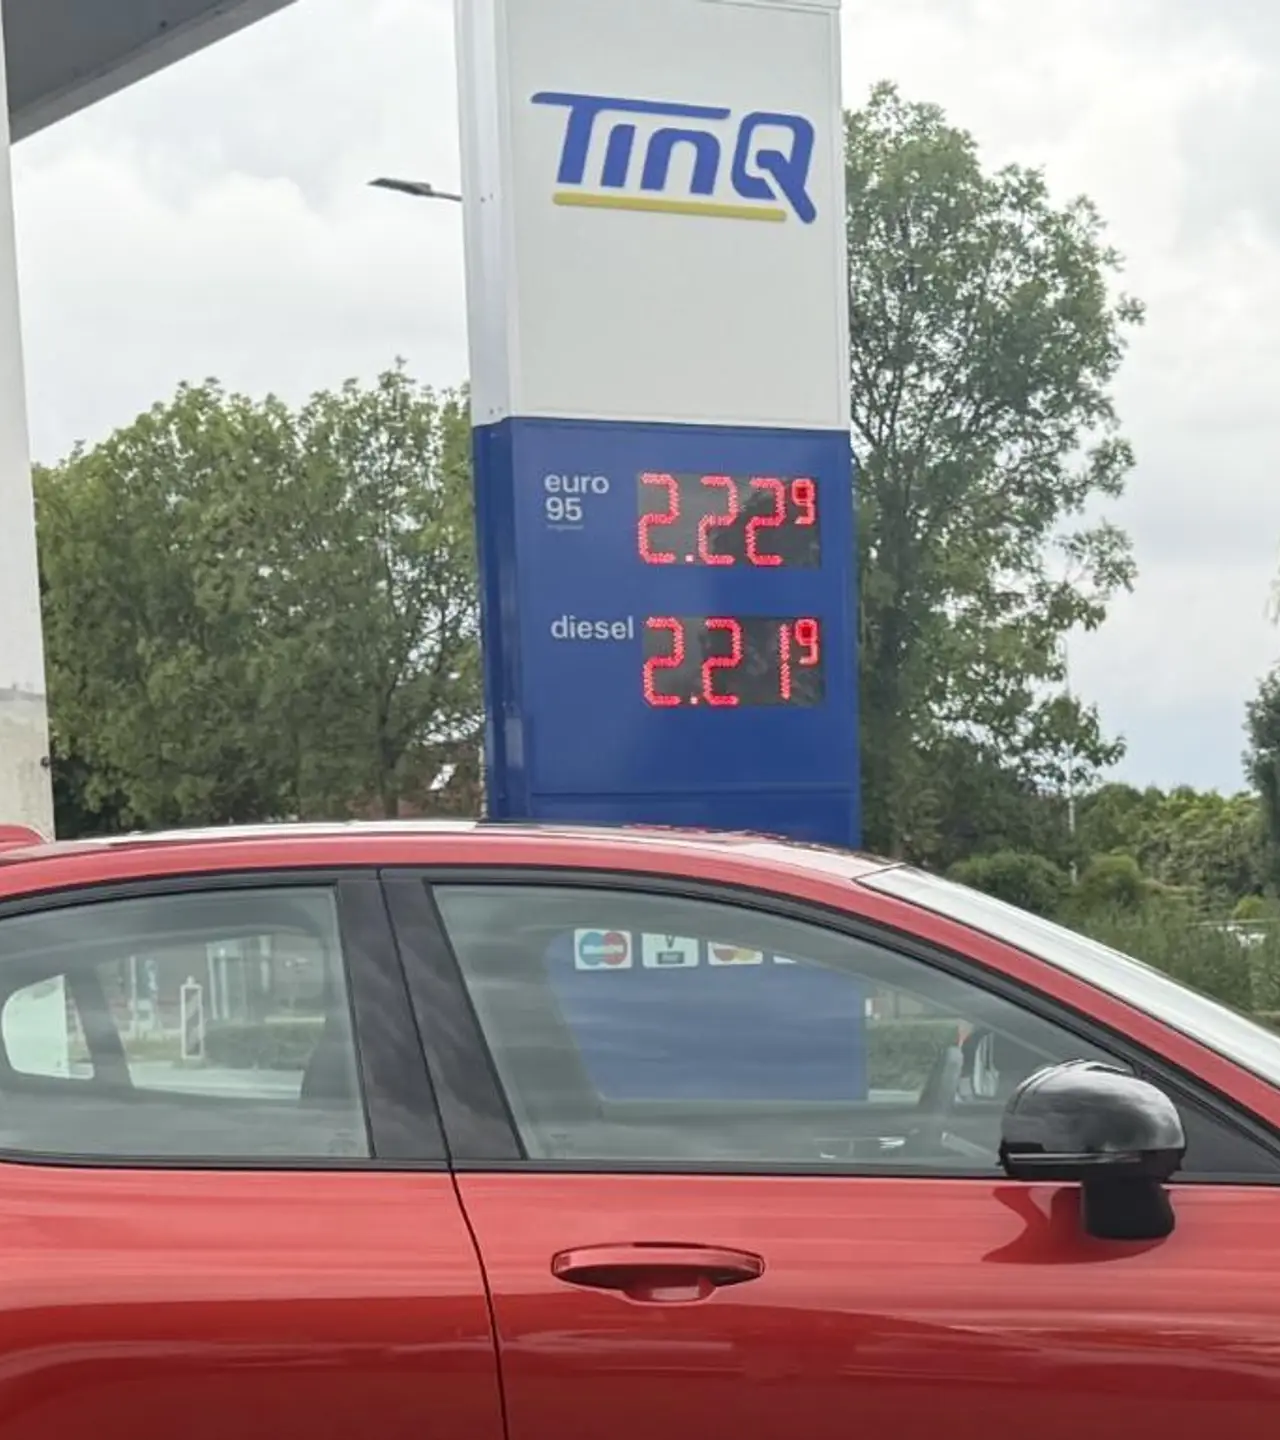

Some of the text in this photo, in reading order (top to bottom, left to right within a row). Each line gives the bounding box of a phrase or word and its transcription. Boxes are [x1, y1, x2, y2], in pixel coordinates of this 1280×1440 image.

[544, 472, 609, 494] euro
[545, 497, 582, 521] 95
[551, 615, 634, 640] diesel
